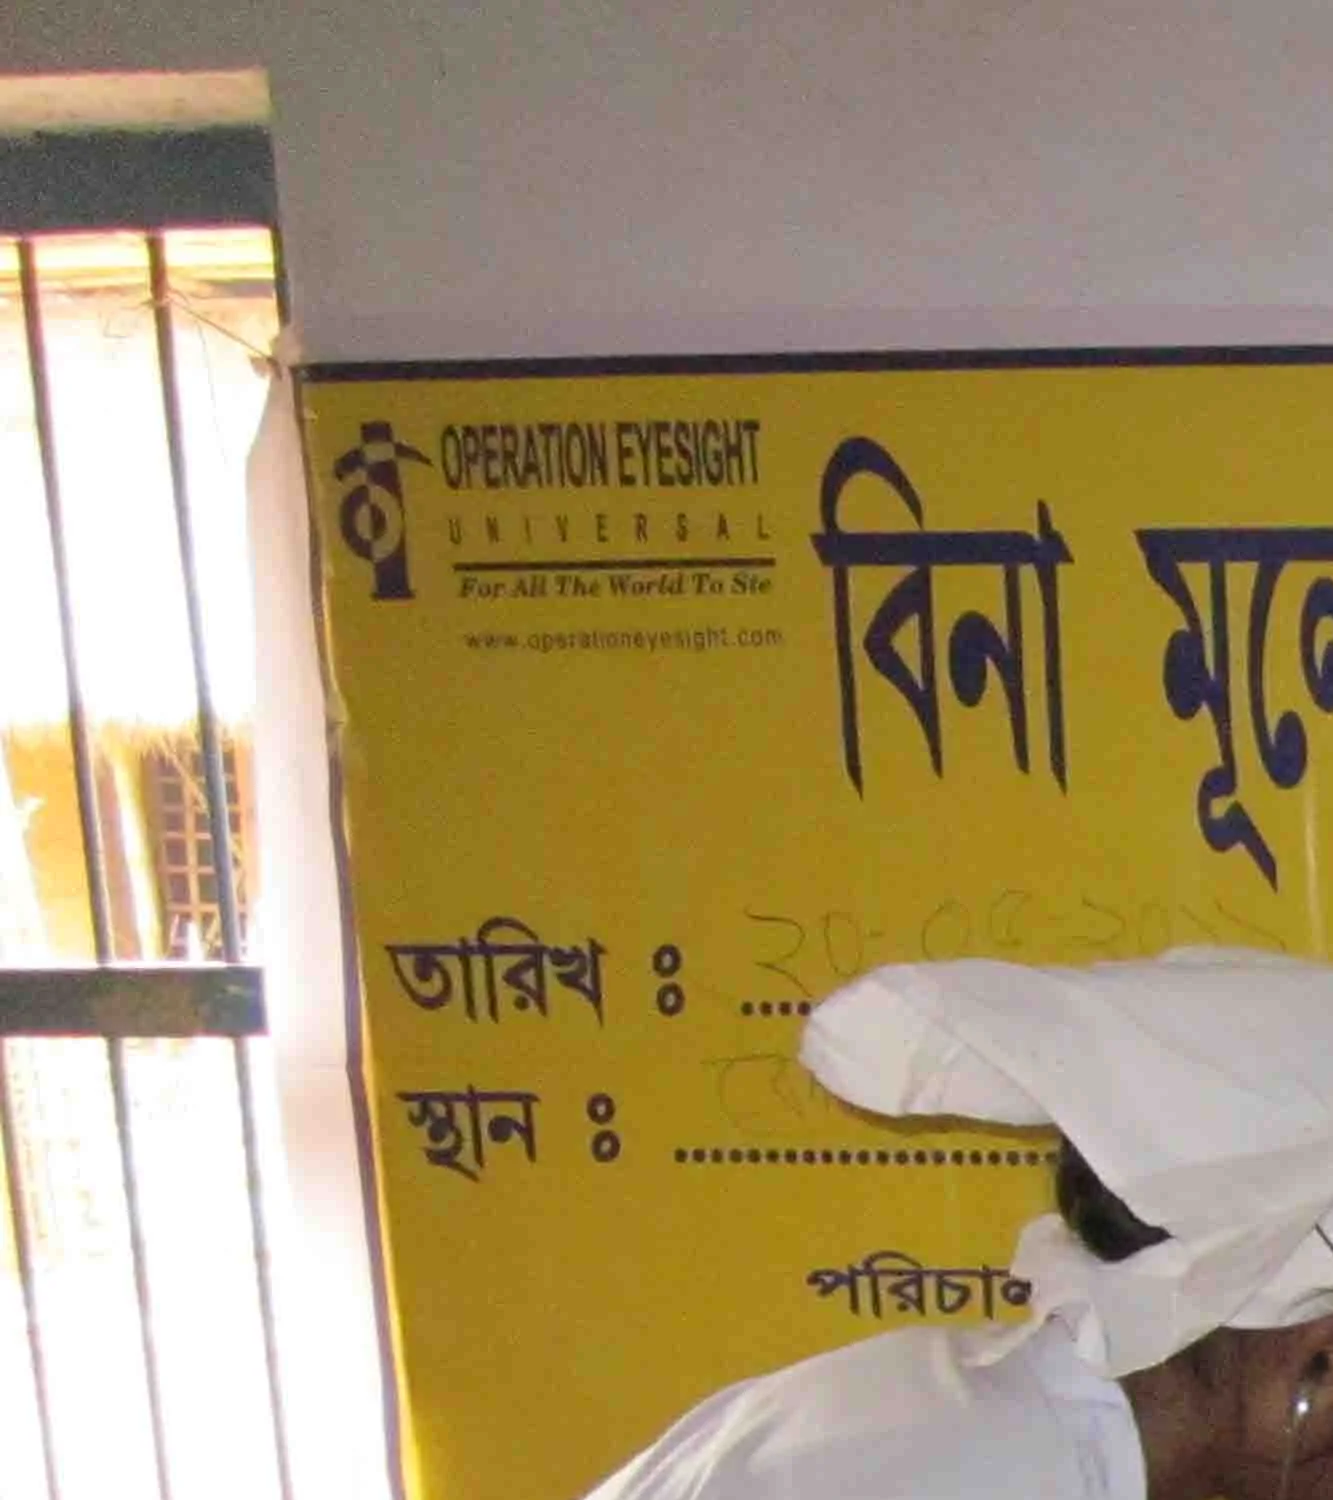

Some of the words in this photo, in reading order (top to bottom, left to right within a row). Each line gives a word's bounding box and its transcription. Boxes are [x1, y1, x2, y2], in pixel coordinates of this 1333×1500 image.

[440, 422, 608, 489] OPERATION
[614, 419, 761, 487] EYESIGHT
[449, 512, 770, 545] UNIVERSAL
[459, 575, 502, 600] For
[511, 575, 547, 598] All
[555, 573, 600, 598] The
[608, 571, 684, 597] World
[691, 571, 724, 596] To
[810, 437, 1074, 799] বিনা
[463, 627, 783, 653] www.operationeyesight.com
[385, 917, 607, 1026] তারিখ
[397, 1084, 541, 1182] স্থান
